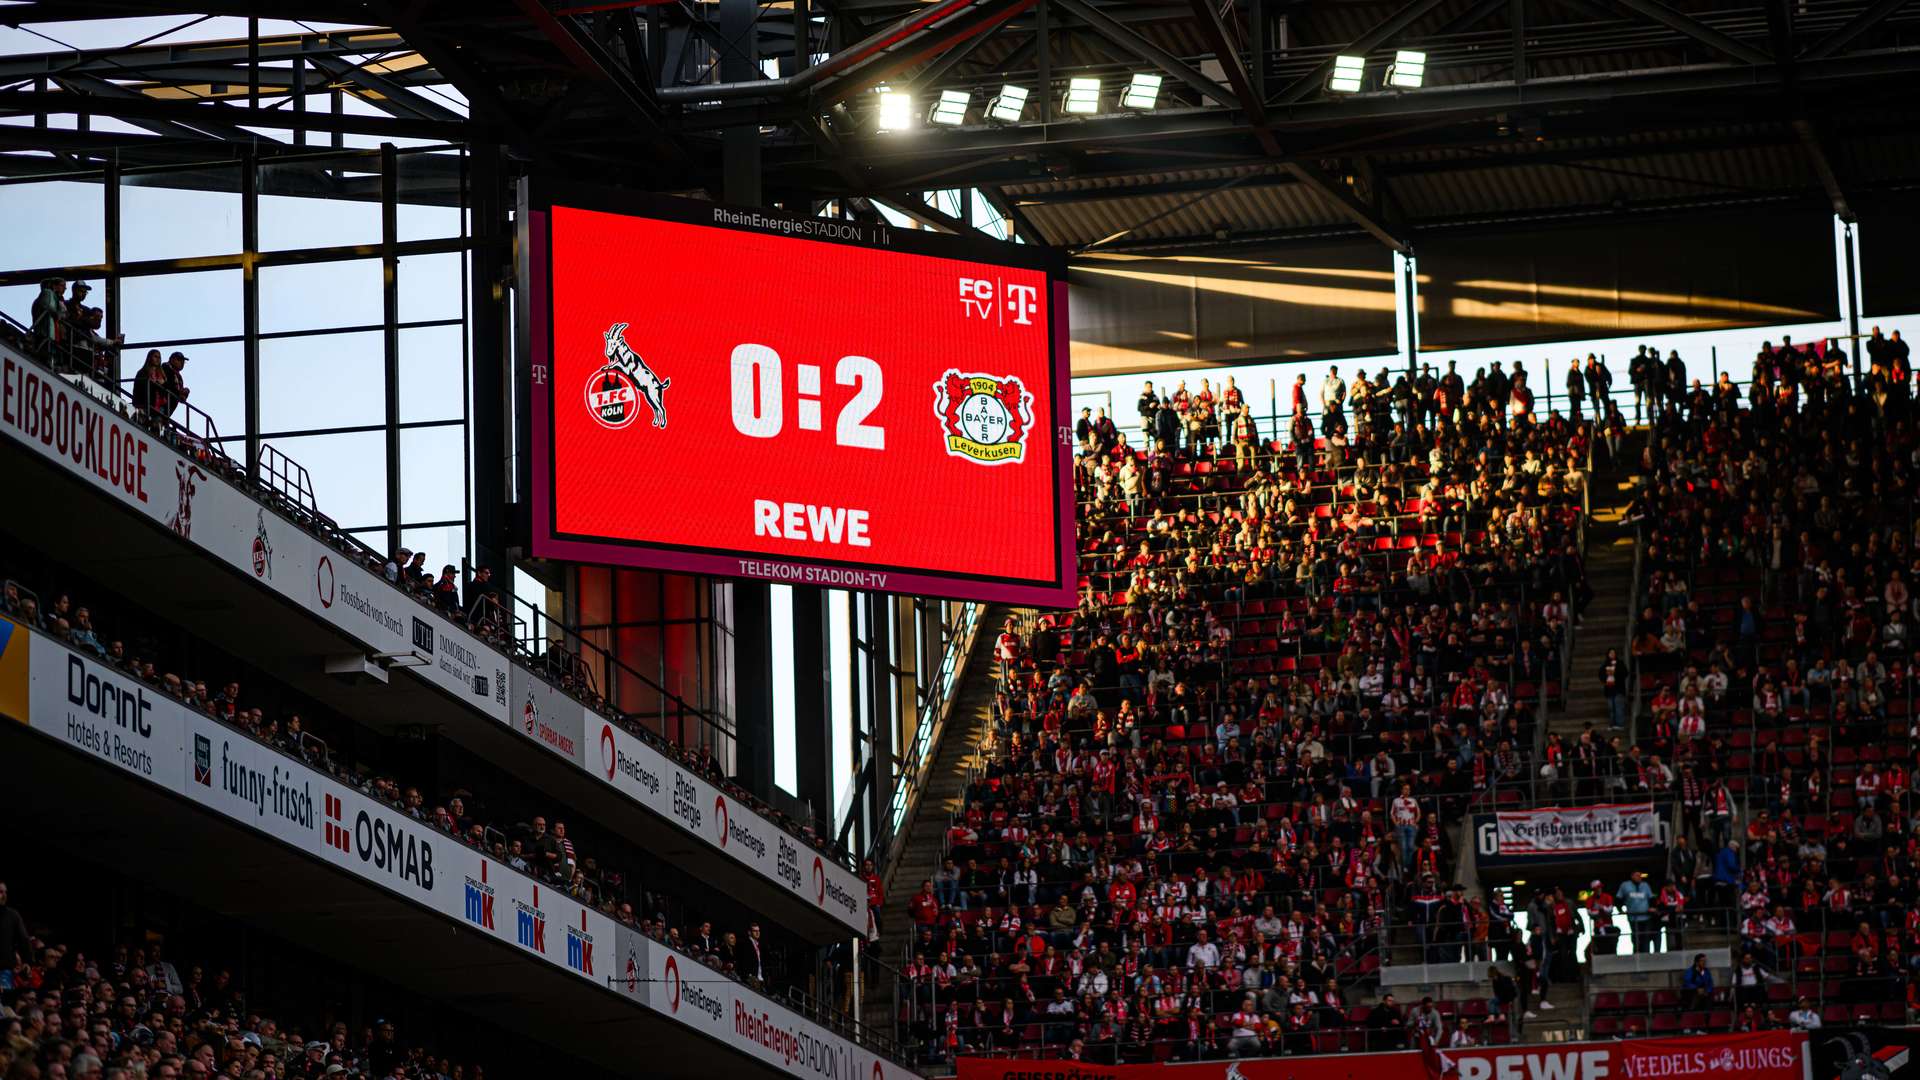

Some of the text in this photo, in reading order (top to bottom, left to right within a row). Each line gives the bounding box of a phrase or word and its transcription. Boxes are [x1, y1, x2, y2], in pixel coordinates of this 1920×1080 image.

[713, 208, 862, 241] RheinEnergieSTADION
[959, 277, 993, 300] FC
[1007, 283, 1037, 326] T
[959, 298, 992, 320] TV
[971, 379, 995, 392] 1904
[601, 404, 625, 418] KÖLN
[965, 412, 1004, 425] BAYER
[953, 438, 1016, 458] Leverkusen
[754, 498, 872, 547] REWE
[738, 559, 887, 588] TELEKOM STADION-TV
[340, 584, 404, 637] Flossbach von Storch
[413, 620, 433, 651] UTH
[68, 653, 152, 738] Dorint
[67, 711, 101, 753] Hotels
[103, 730, 110, 757] &
[114, 734, 152, 775] Resorts
[222, 741, 314, 830] funny-frisch
[617, 749, 660, 795] RheinEnergie
[675, 771, 697, 805] Rhein
[673, 797, 701, 829] Energie
[355, 809, 434, 891] OSMAB
[729, 821, 766, 859] RheinEnergie
[779, 835, 797, 868] Rhein
[777, 856, 801, 889] Energie
[825, 877, 857, 914] RheinEnergie
[681, 980, 723, 1022] RheinEnergie
[1624, 1046, 1793, 1079] VEEDELS JUNGS
